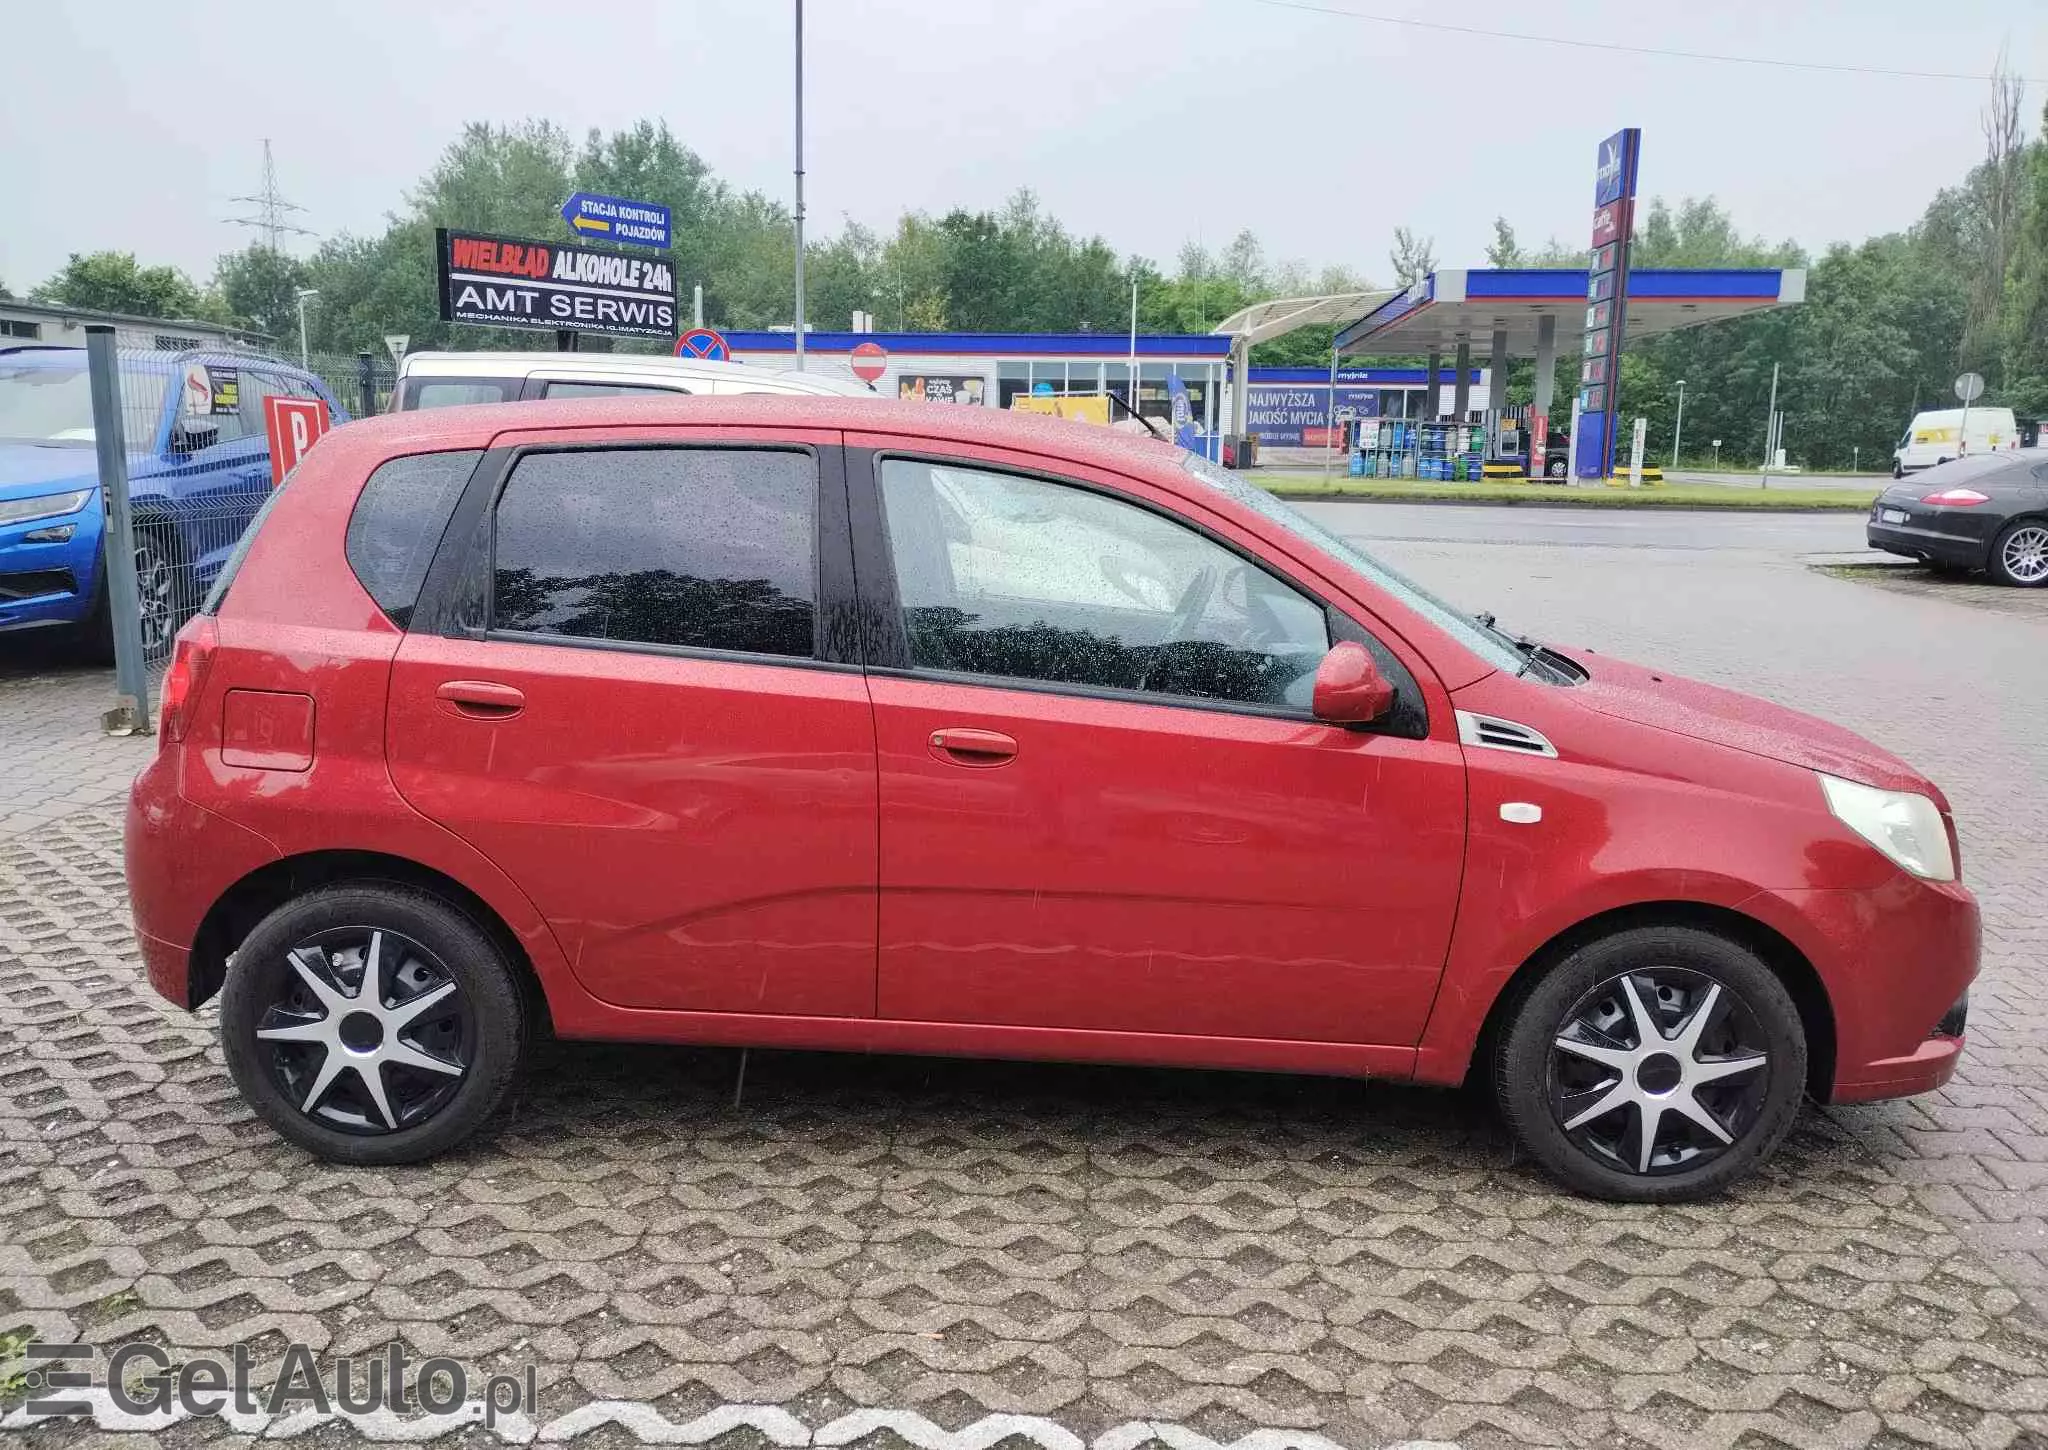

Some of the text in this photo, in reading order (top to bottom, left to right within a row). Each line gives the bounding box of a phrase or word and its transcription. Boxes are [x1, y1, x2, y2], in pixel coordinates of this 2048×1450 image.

[581, 200, 665, 225] STACJA KONTROLI
[615, 222, 666, 241] POJAZDÓW
[453, 238, 672, 293] WIELBŁĄD ALKOHOLE 24h
[456, 286, 673, 327] AMT SERWIS
[456, 312, 673, 336] MECHANIKA ELEKTRONIKA KLIMATYZACJA
[926, 385, 953, 394] CZAS
[1248, 389, 1315, 407] NAJWYŻSZA
[1247, 407, 1325, 425] JAKOŚĆ MYCIA
[290, 411, 308, 464] P
